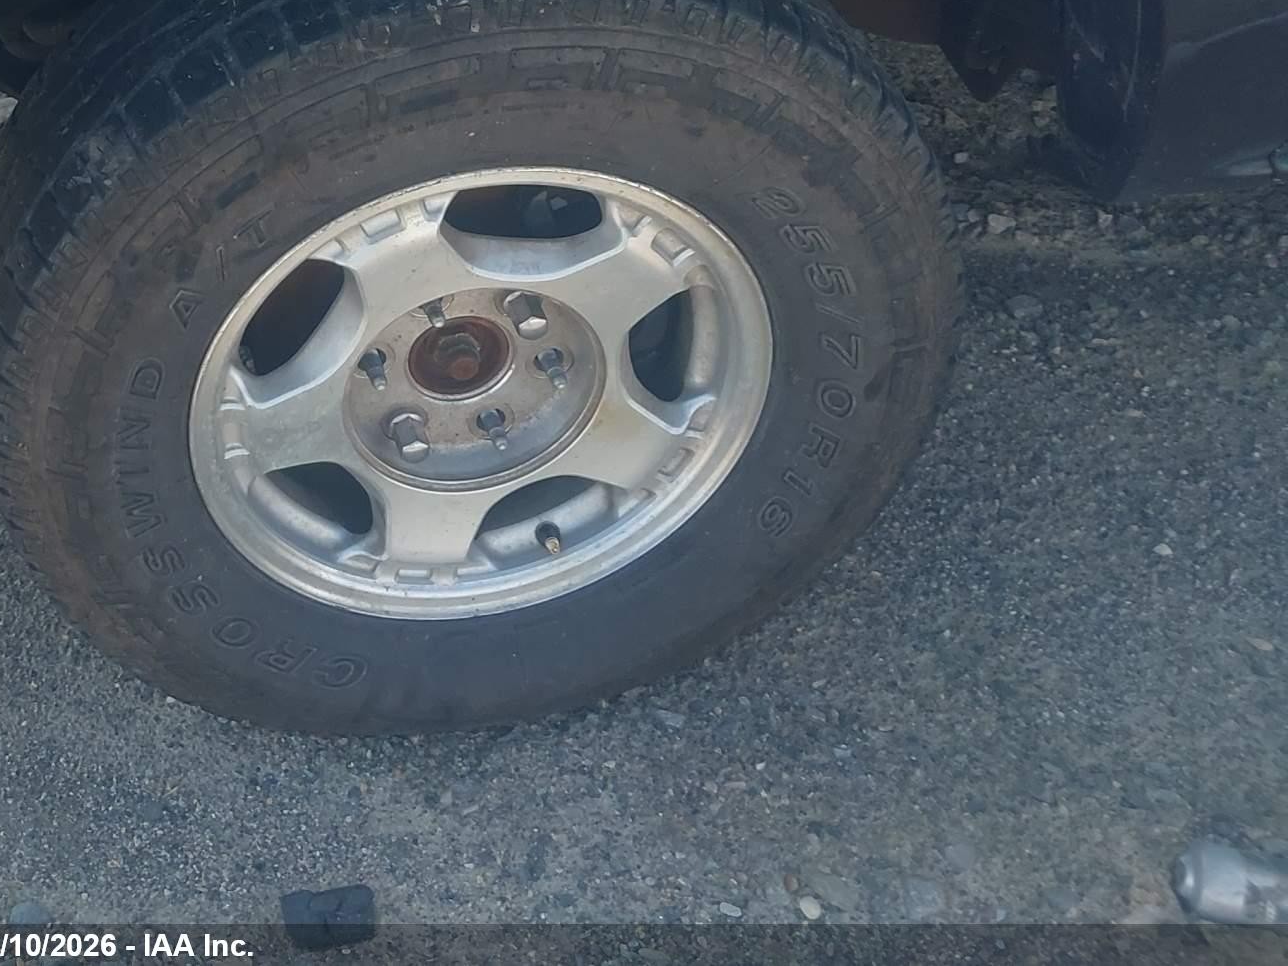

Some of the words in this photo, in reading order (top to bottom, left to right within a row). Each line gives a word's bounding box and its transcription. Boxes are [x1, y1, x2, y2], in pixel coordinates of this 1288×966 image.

[166, 210, 274, 331] A/T
[750, 184, 859, 537] 255/70R16
[116, 356, 370, 690] CROSSWIND
